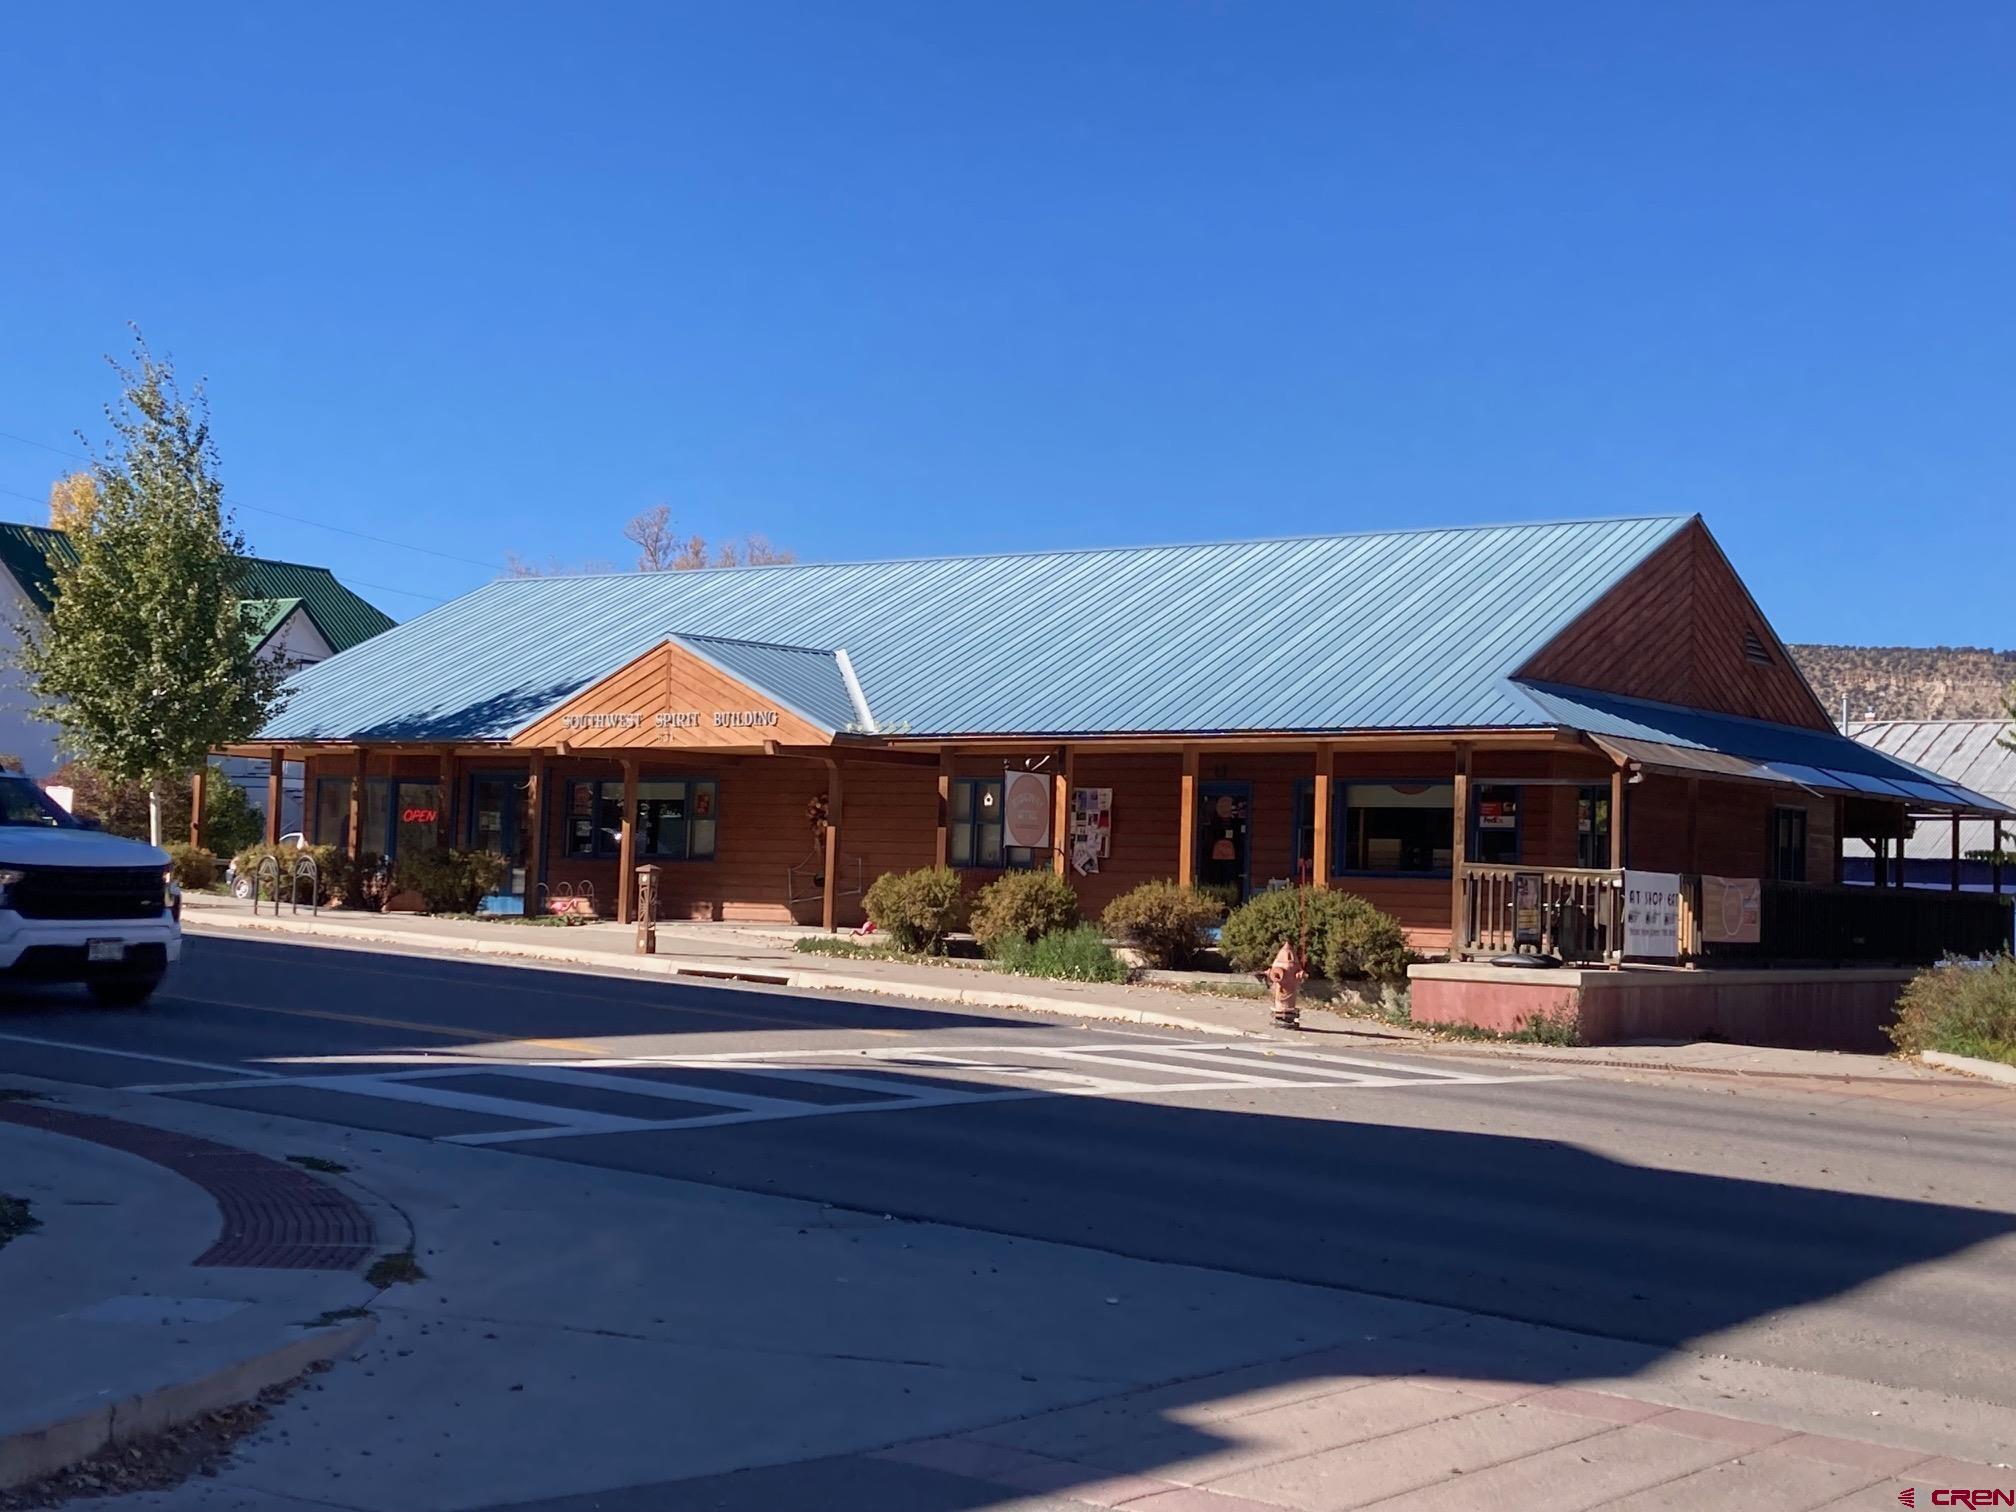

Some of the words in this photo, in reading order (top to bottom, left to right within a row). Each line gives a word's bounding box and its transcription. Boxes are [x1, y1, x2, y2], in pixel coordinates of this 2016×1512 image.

[563, 713, 642, 729] SOUTHWEST
[656, 712, 701, 728] SPIRIT
[713, 711, 779, 728] BUILDING
[403, 809, 437, 822] OPEN
